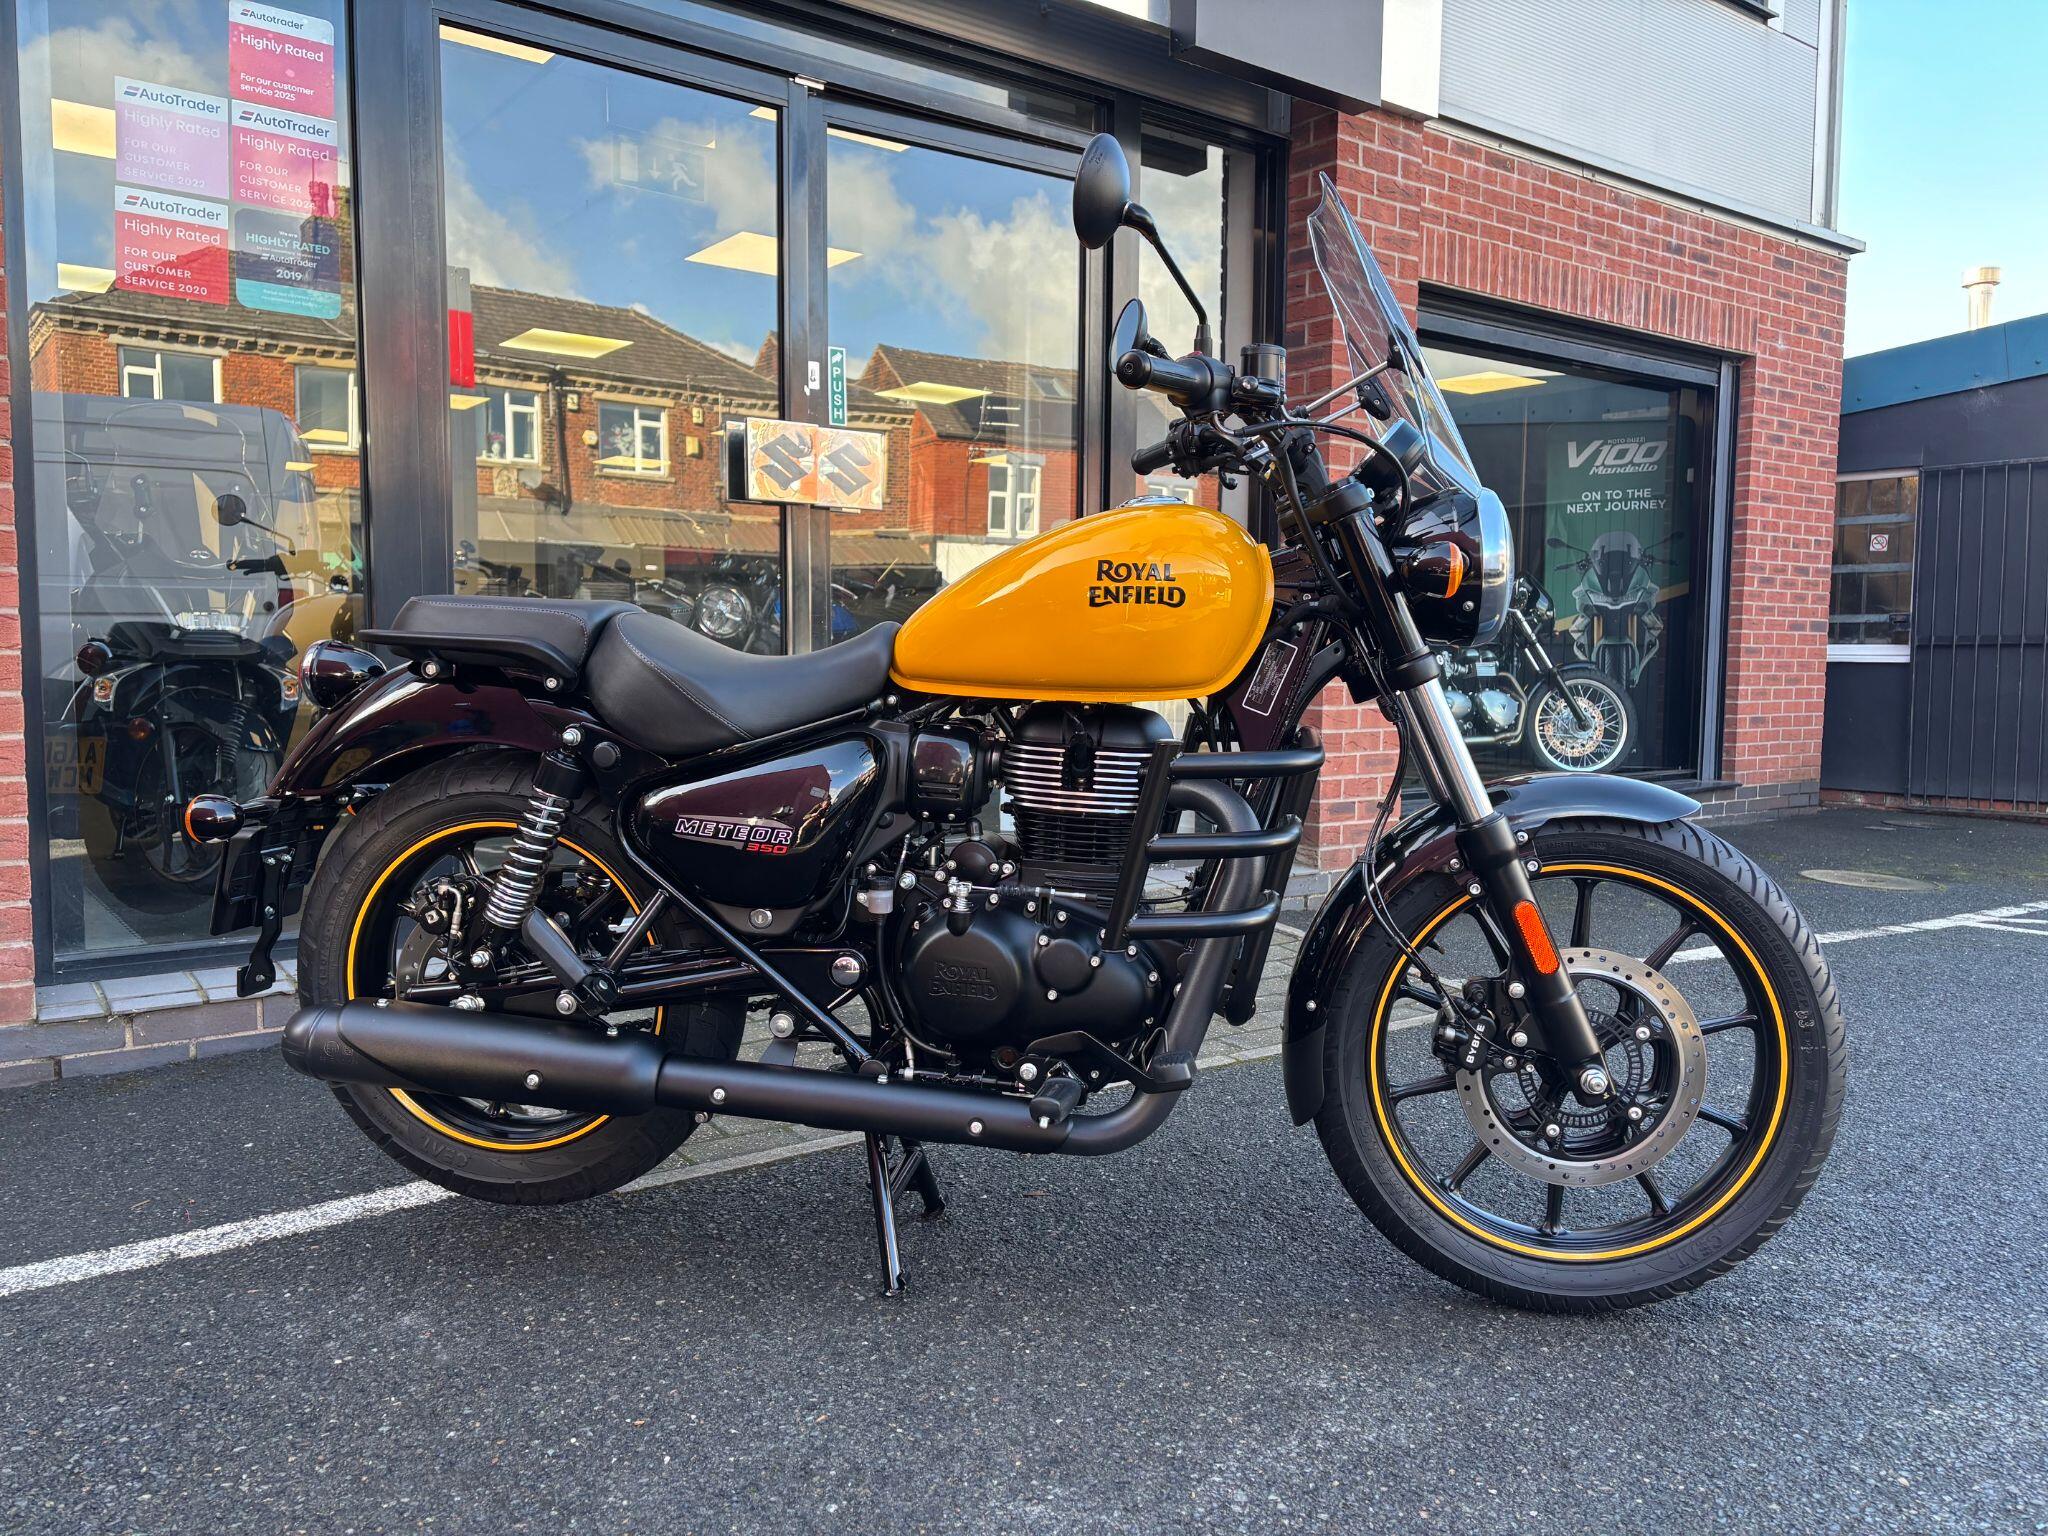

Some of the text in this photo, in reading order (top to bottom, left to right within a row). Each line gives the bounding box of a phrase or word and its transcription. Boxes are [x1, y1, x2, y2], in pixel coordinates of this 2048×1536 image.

[249, 11, 304, 30] Autotrader
[240, 33, 324, 62] Highly Rated
[240, 72, 315, 96] For our customer
[240, 83, 296, 101] service 2025
[139, 88, 221, 114] AutoTrader
[124, 109, 220, 138] Highly Rated
[253, 112, 330, 138] AutoTrader
[124, 137, 177, 154] FOR OUR
[240, 133, 330, 161] Highly Rated
[124, 152, 191, 172] CUSTOMER
[240, 160, 288, 177] FOR OUR
[124, 166, 205, 188] SERVICE 2022
[240, 175, 302, 193] CUSTOMER
[240, 189, 287, 205] SERVICE
[139, 197, 221, 221] AutoTrader
[124, 218, 220, 245] Highly Rated
[124, 246, 177, 262] FOR OUR
[245, 232, 290, 248] HIGHLY
[292, 240, 331, 255] RATED
[124, 260, 192, 279] CUSTOMER
[269, 254, 318, 269] AutoTrader
[124, 275, 208, 296] SERVICE 2020
[275, 269, 303, 281] 2019
[832, 366, 843, 420] PUSH
[1567, 439, 1668, 469] V100
[1588, 462, 1658, 476] Mandello
[1581, 488, 1652, 501] ON TO THE
[1566, 499, 1667, 515] NEXT JOURNEY
[1096, 559, 1177, 583] ROYAL
[1088, 585, 1186, 609] ENFIELD
[675, 818, 793, 845] METEOR
[745, 842, 788, 855] 350
[934, 960, 992, 983] ROYAL
[927, 974, 1001, 1001] ENFIELD
